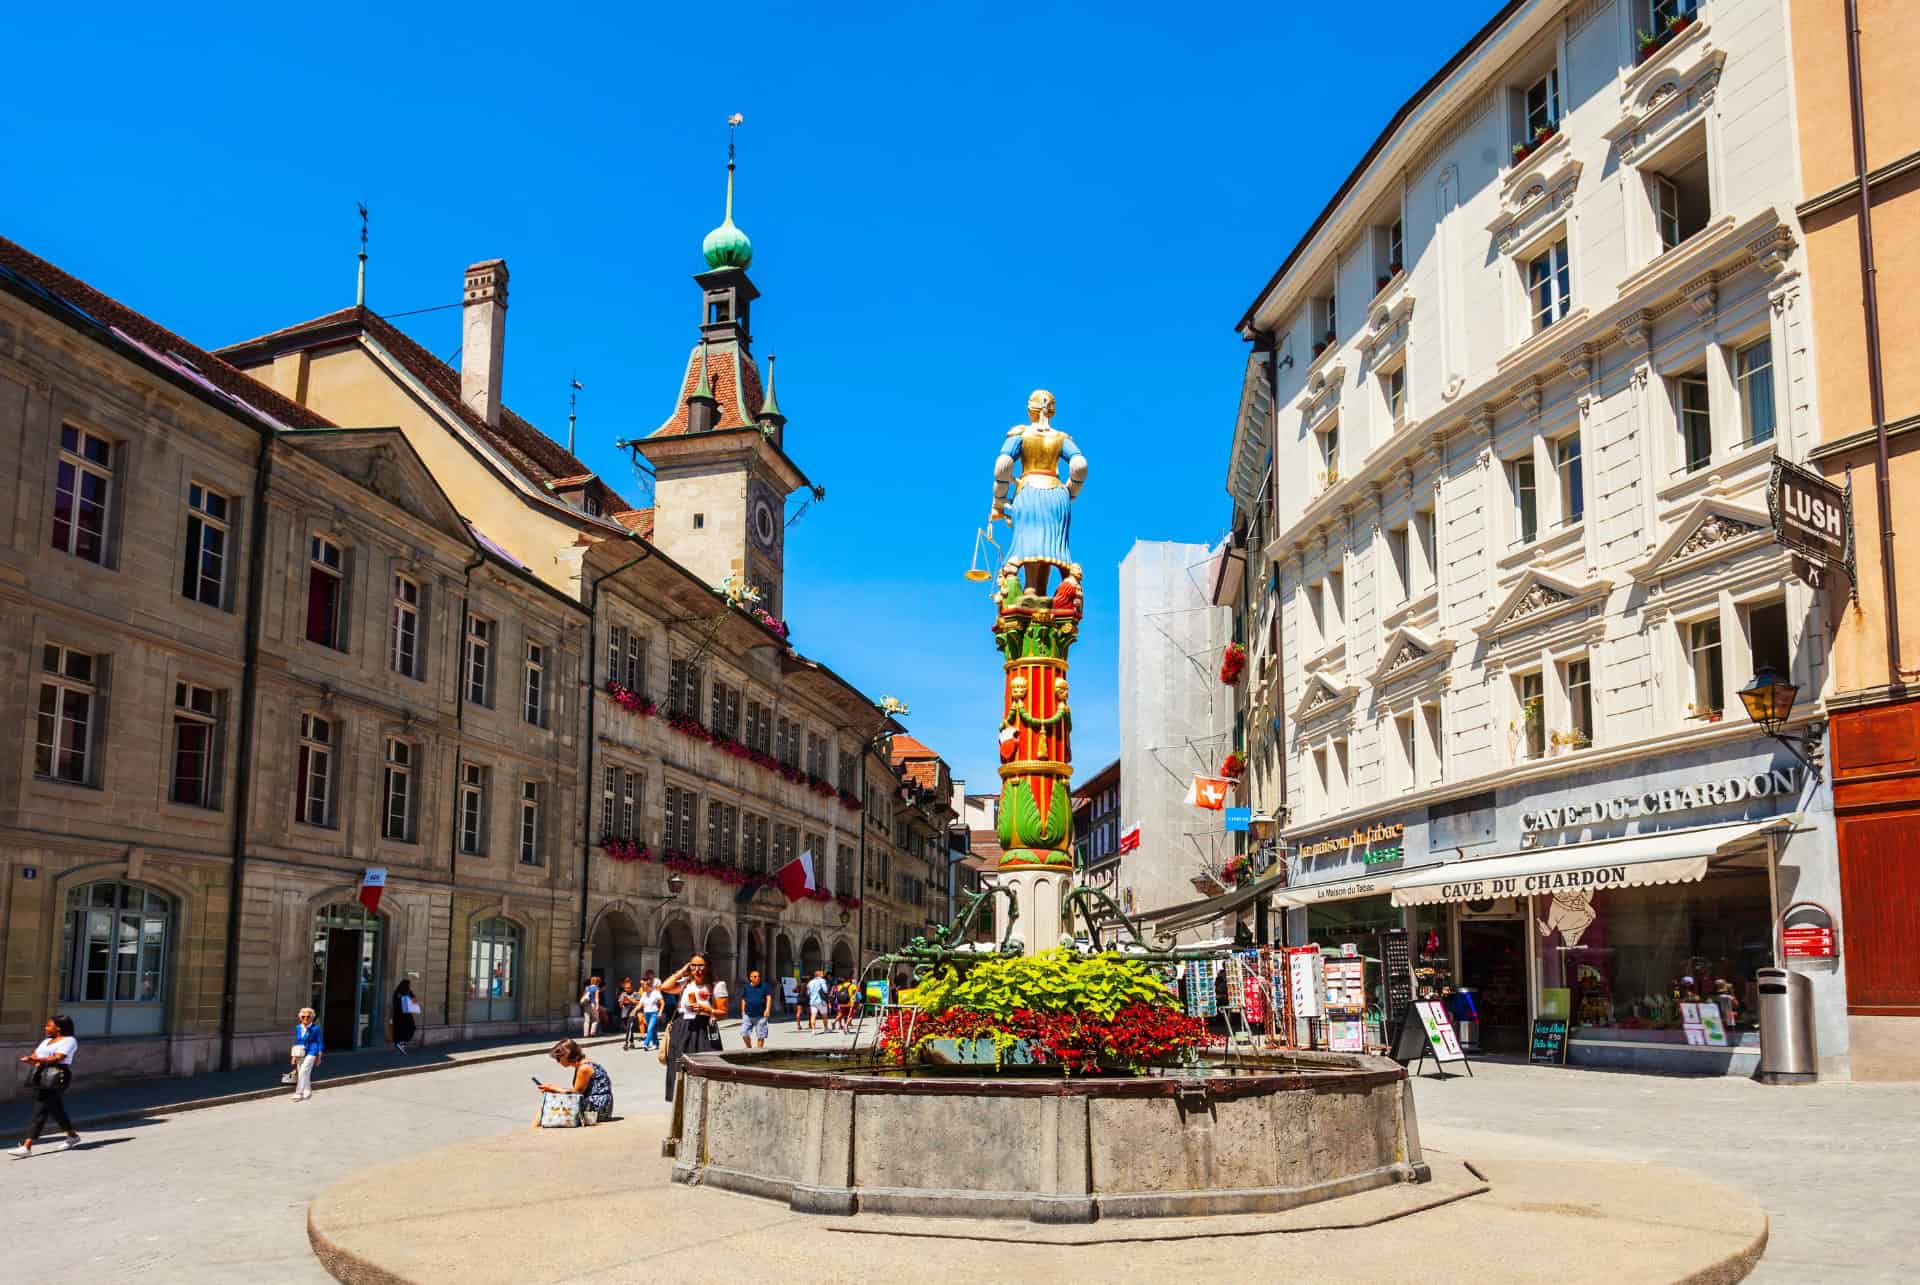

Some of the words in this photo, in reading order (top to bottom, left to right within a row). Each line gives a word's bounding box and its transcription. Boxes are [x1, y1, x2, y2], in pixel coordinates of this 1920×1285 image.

[1784, 483, 1841, 536] LUSH
[1519, 803, 1584, 832] CAVE
[1590, 797, 1627, 822] DU
[1639, 768, 1798, 814] CHARDON
[1313, 836, 1349, 854] maison
[1350, 829, 1367, 846] du
[1367, 823, 1405, 842] tabac
[1326, 887, 1347, 897] Maison
[1356, 883, 1375, 893] Tabac
[1442, 882, 1483, 898] CAVE
[1493, 879, 1516, 894] DU
[1525, 867, 1626, 890] CHARDON
